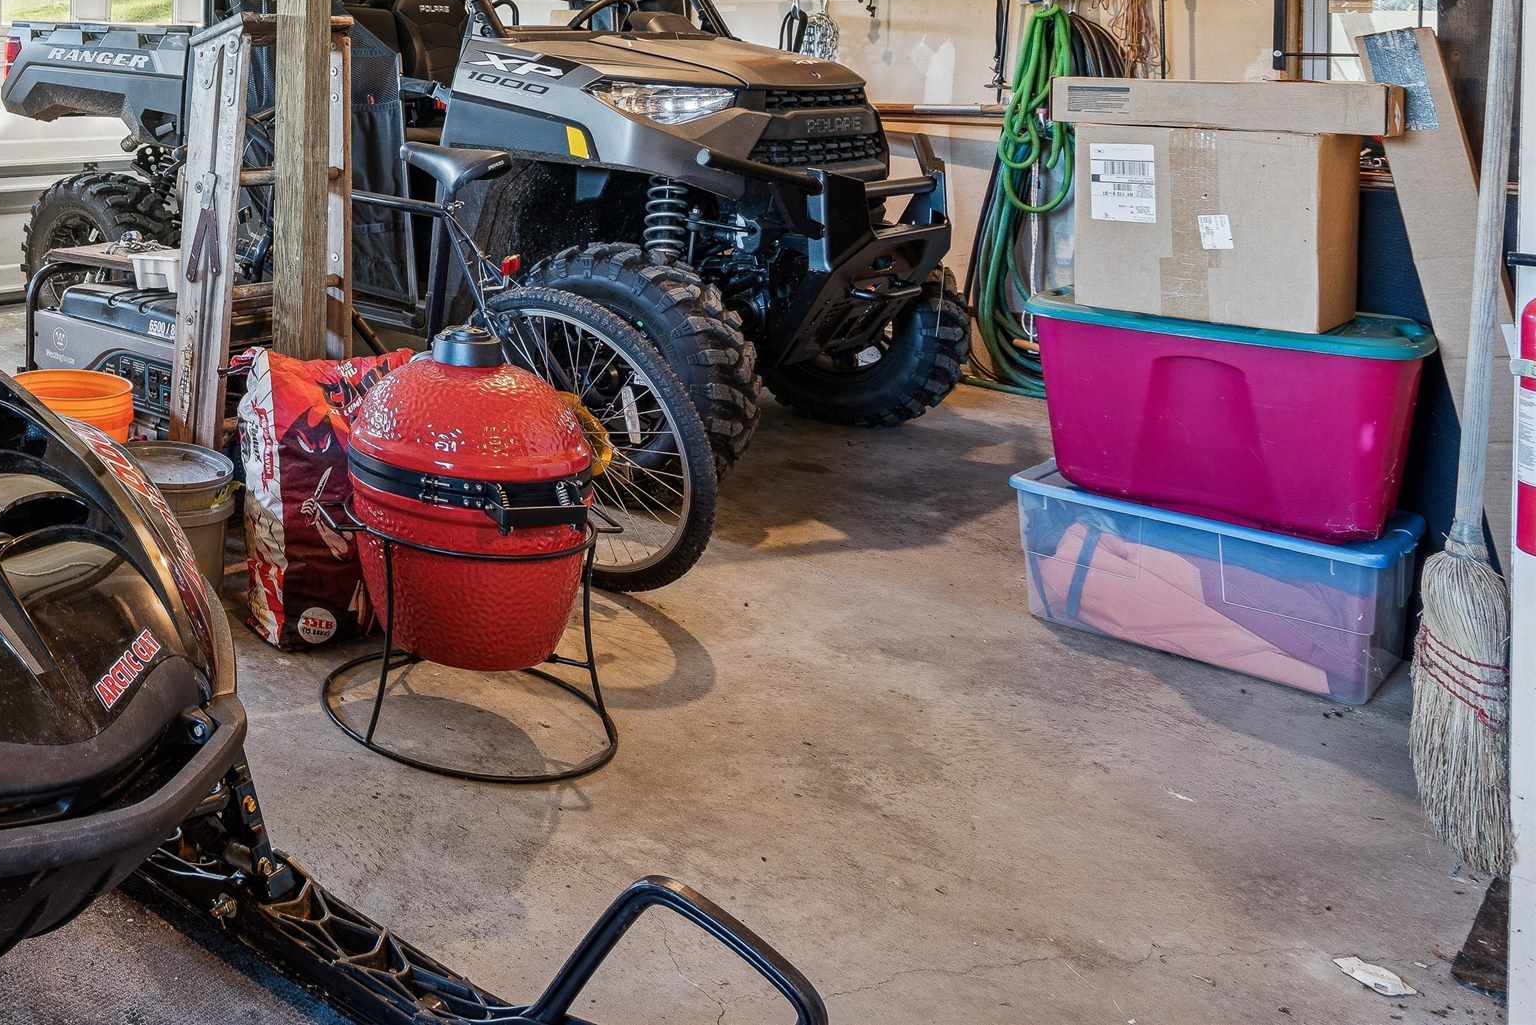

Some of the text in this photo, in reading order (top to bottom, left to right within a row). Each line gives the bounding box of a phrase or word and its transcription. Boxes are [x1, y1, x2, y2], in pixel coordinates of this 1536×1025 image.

[47, 47, 149, 69] RANGER
[470, 51, 563, 78] XP
[468, 71, 550, 95] 1000
[93, 627, 162, 710] ARCTIC CAT
